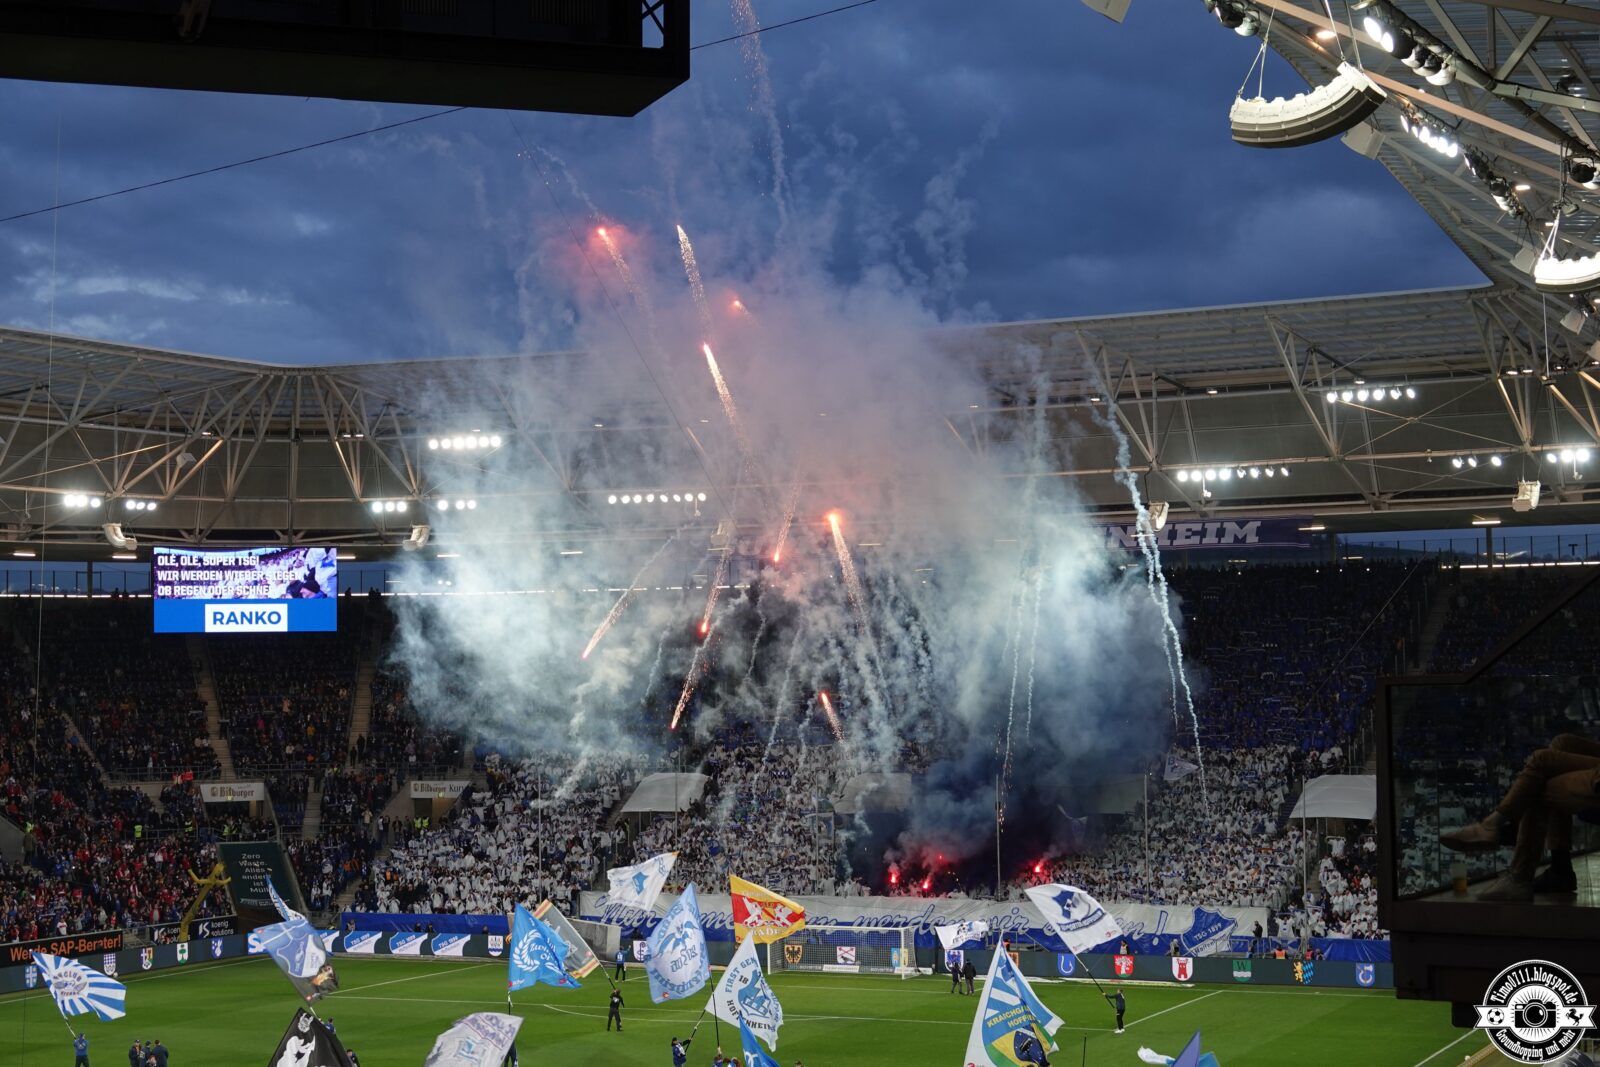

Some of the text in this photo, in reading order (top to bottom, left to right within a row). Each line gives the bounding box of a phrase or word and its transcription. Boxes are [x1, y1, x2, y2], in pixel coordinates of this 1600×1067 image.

[203, 556, 236, 566] SUPER
[238, 556, 260, 566] TSG!
[157, 570, 179, 581] WIR
[181, 570, 222, 581] WERDEN
[224, 570, 263, 581] WIEDER
[158, 585, 172, 596] OB
[173, 585, 206, 596] REGEN
[207, 585, 236, 596] ODER
[212, 610, 282, 626] RANKO
[219, 786, 255, 798] Bitburger
[211, 920, 229, 928] koenig
[211, 928, 234, 937] solutions
[1194, 922, 1223, 941] TSG 1899
[725, 967, 741, 993] FIRST
[738, 975, 749, 984] 18
